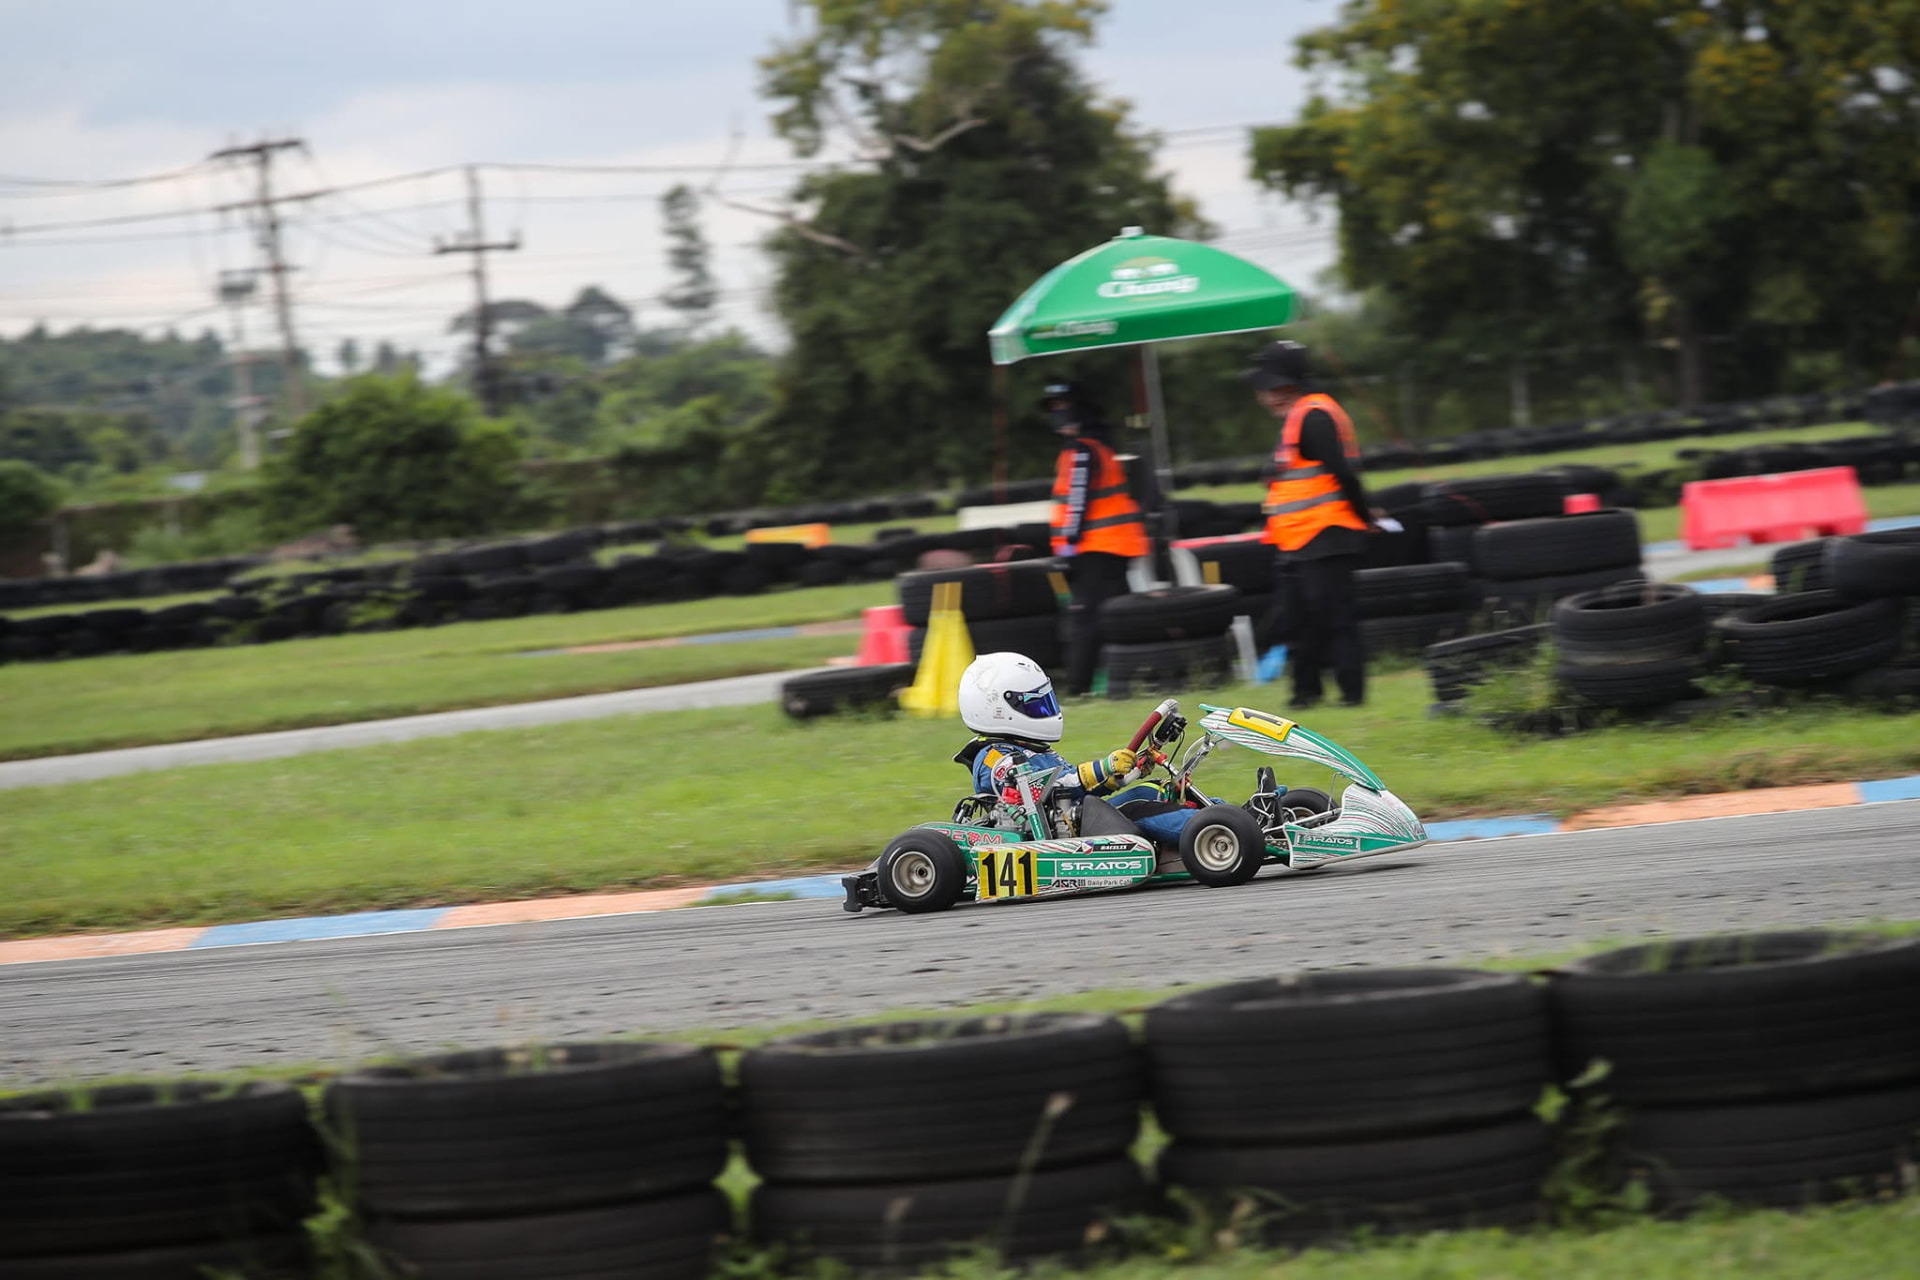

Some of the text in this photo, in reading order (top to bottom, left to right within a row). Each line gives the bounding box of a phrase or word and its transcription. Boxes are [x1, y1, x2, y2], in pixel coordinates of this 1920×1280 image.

[1096, 275, 1200, 298] Chang
[1305, 835, 1354, 845] STRATOS
[1060, 861, 1142, 871] STRATOS
[981, 851, 1033, 897] 141
[1087, 879, 1103, 887] Daily
